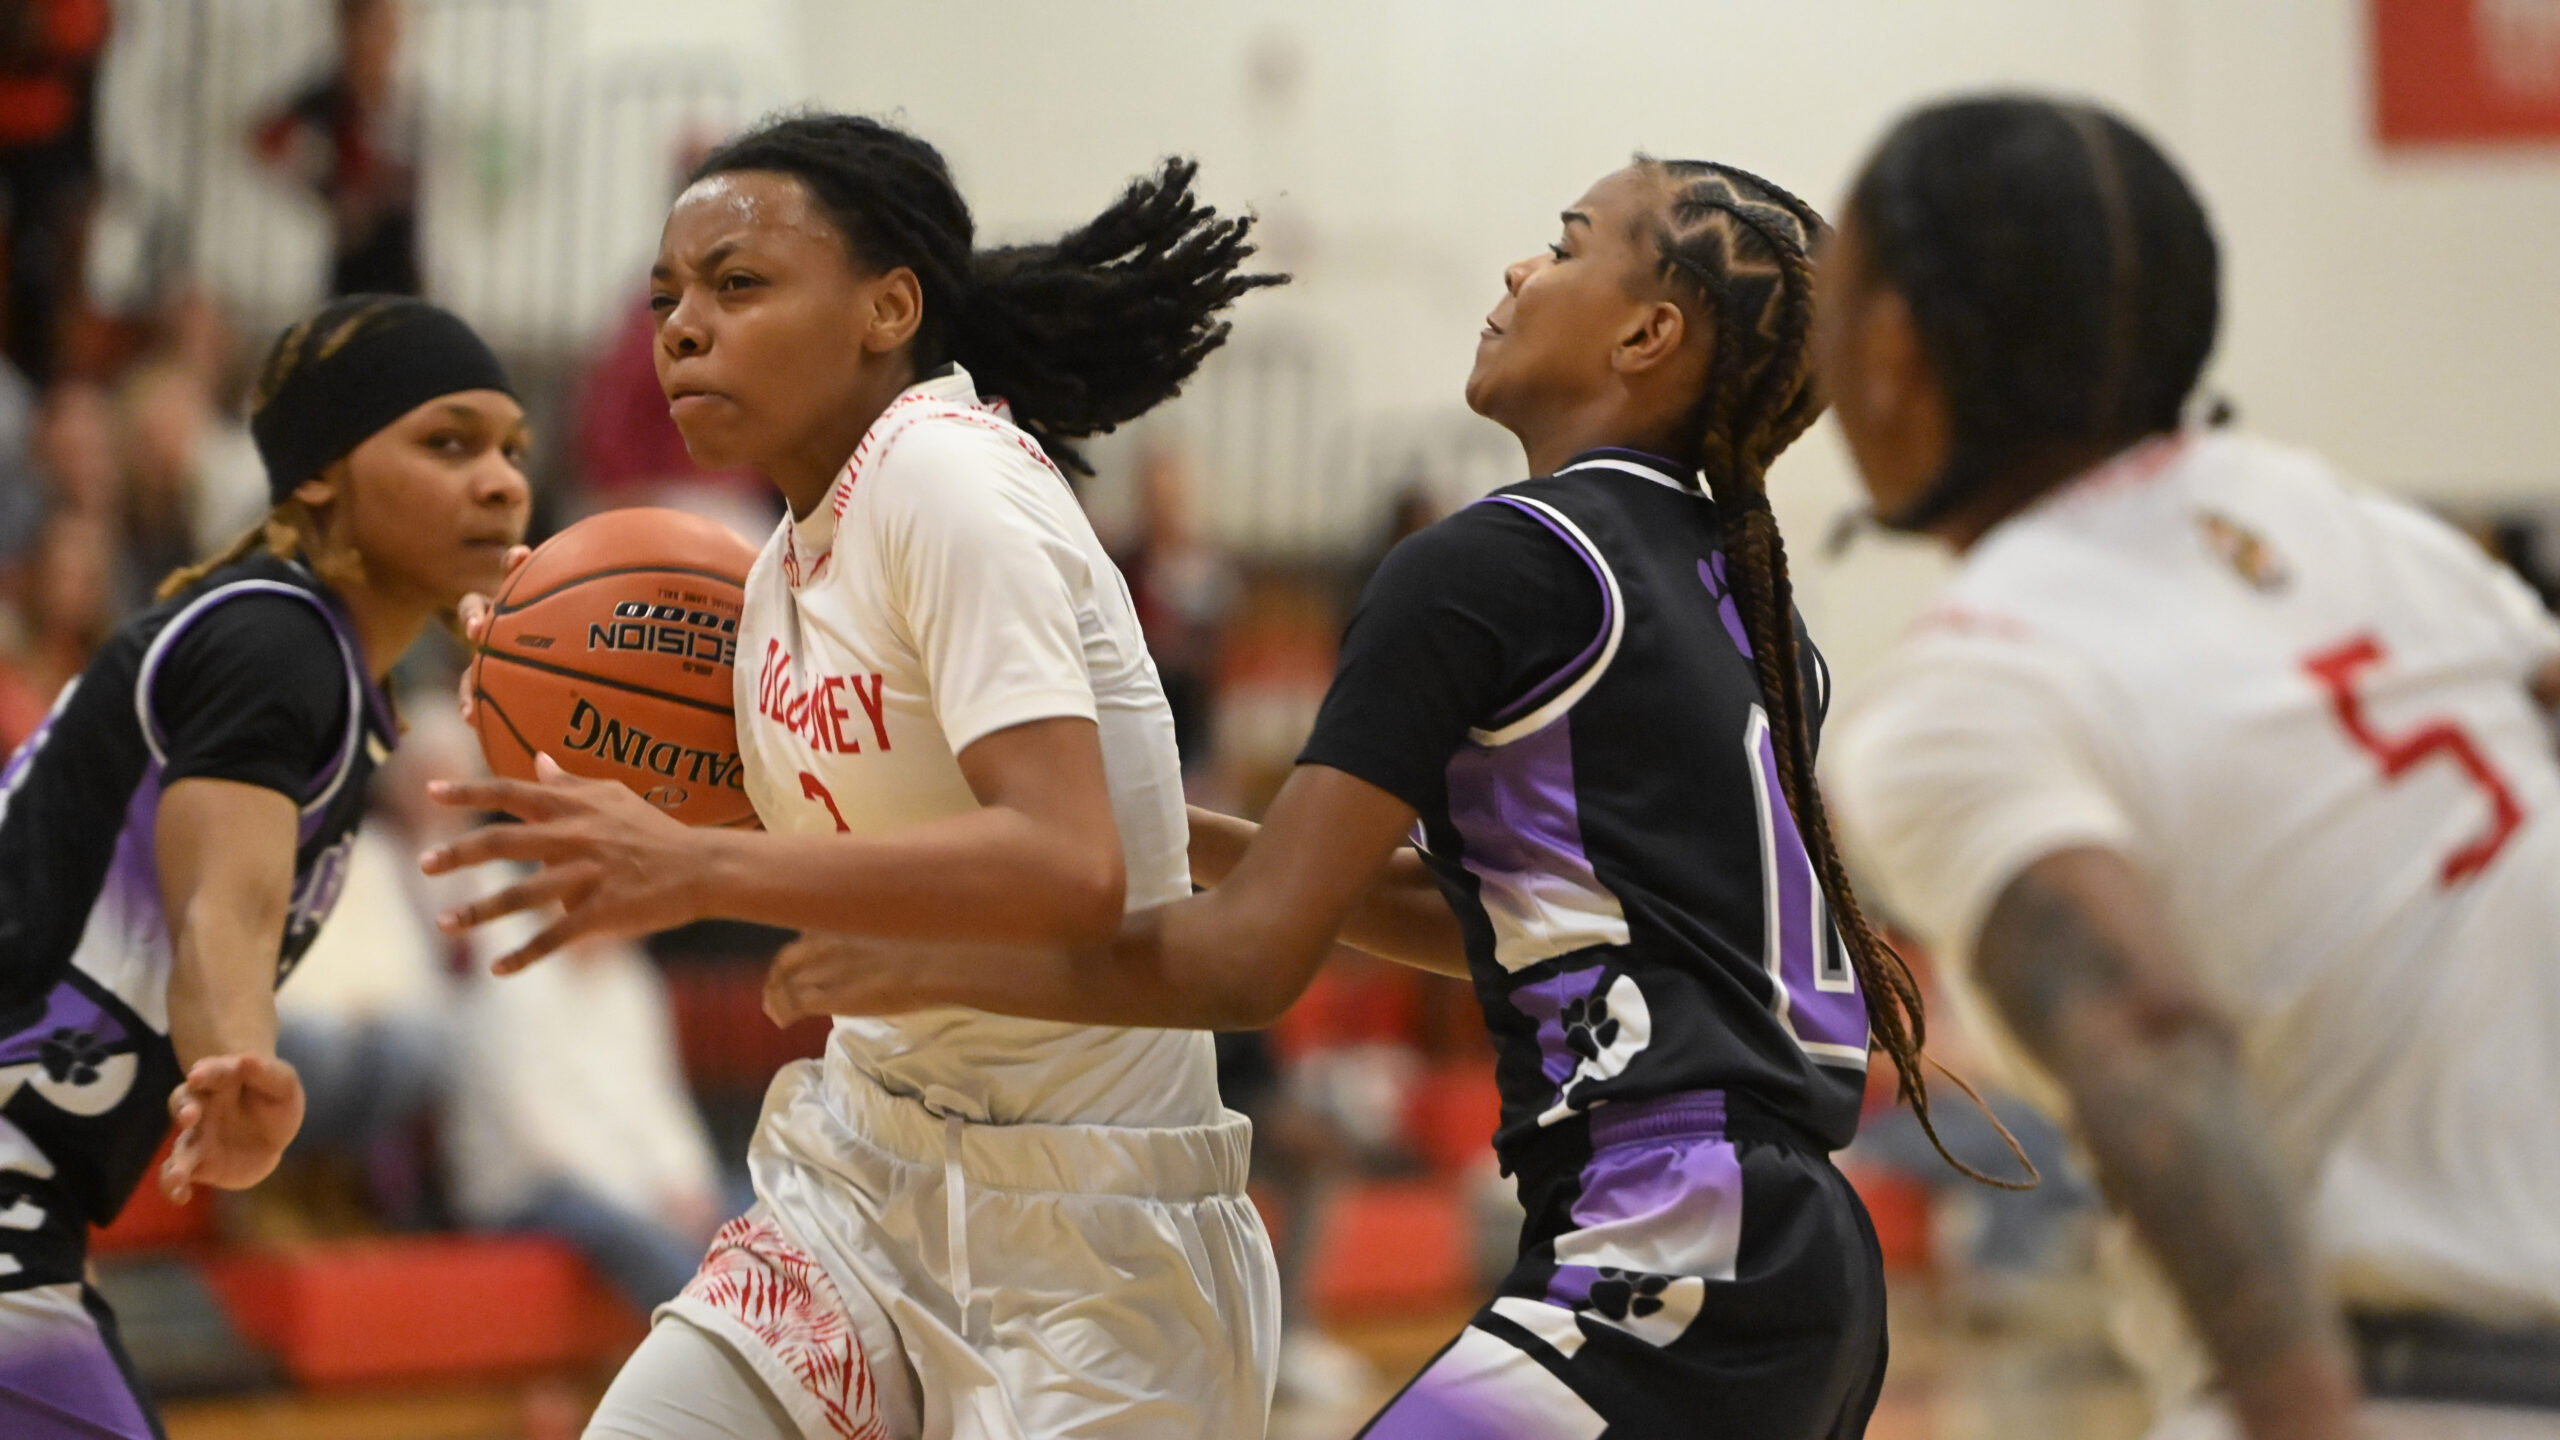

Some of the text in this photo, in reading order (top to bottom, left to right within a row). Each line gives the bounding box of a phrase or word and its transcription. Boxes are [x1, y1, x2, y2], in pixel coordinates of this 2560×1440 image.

[587, 622, 737, 667] ECISION
[563, 698, 744, 790] PALDING
[2297, 633, 2526, 887] 5
